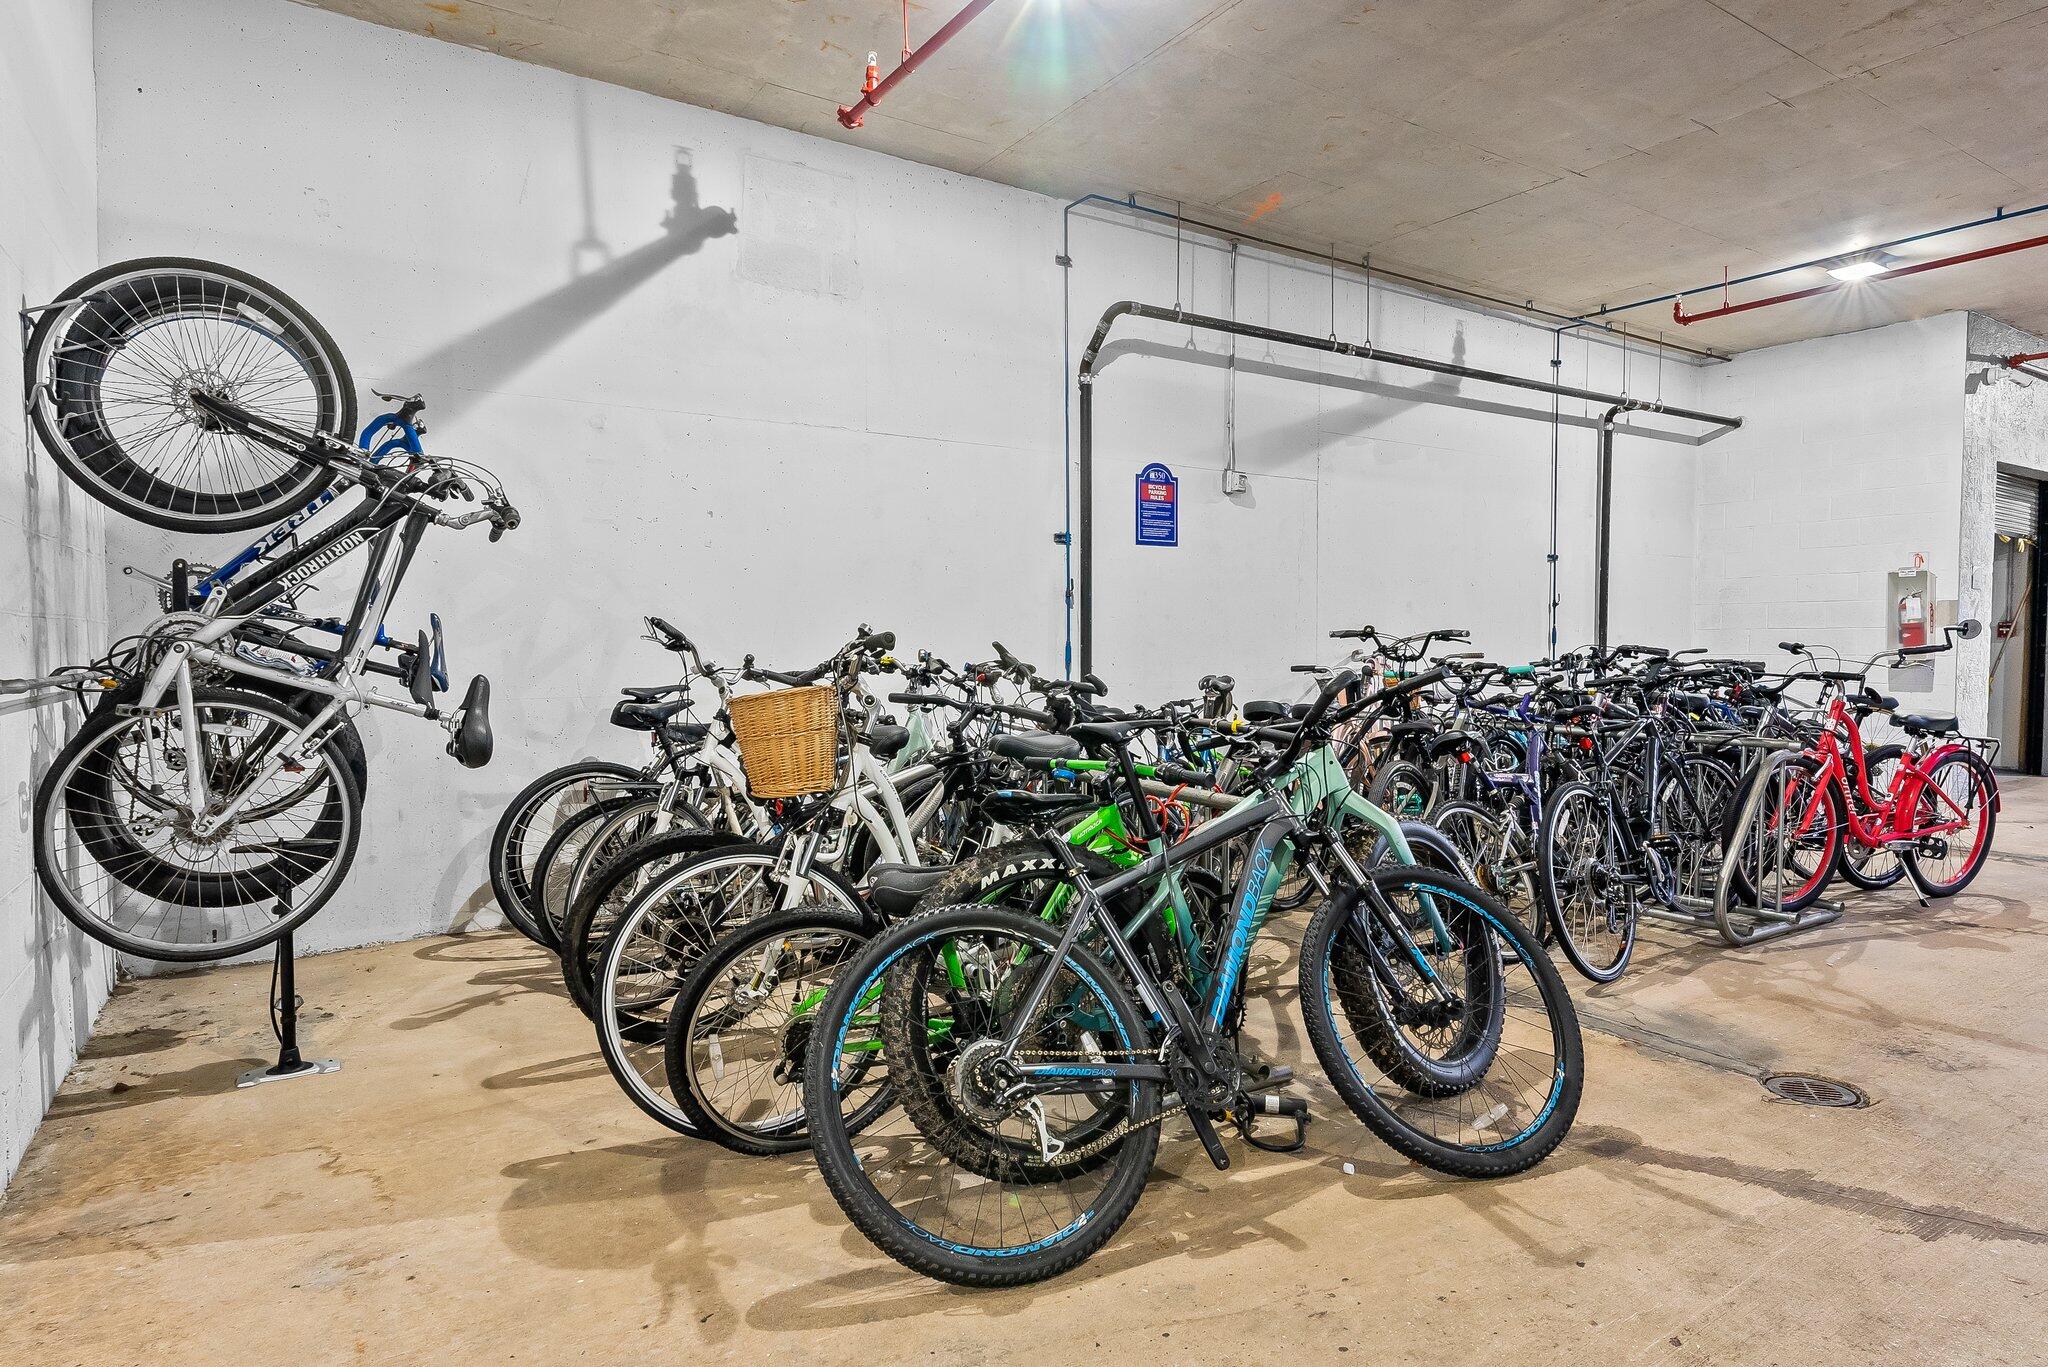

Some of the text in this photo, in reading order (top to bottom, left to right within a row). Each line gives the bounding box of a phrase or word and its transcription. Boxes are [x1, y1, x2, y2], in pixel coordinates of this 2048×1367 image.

[253, 494, 330, 555] TREK
[277, 531, 365, 591] NORTHROCK
[980, 857, 1066, 891] MAXX
[1211, 839, 1273, 1026] DIAMONDBACK
[1418, 882, 1538, 969] DIAMONDBACK
[831, 931, 938, 1072] DIAMONDBACK
[1034, 1066, 1118, 1077] DIAMONDBACK
[898, 1215, 1081, 1258] DIAMONDBACK
